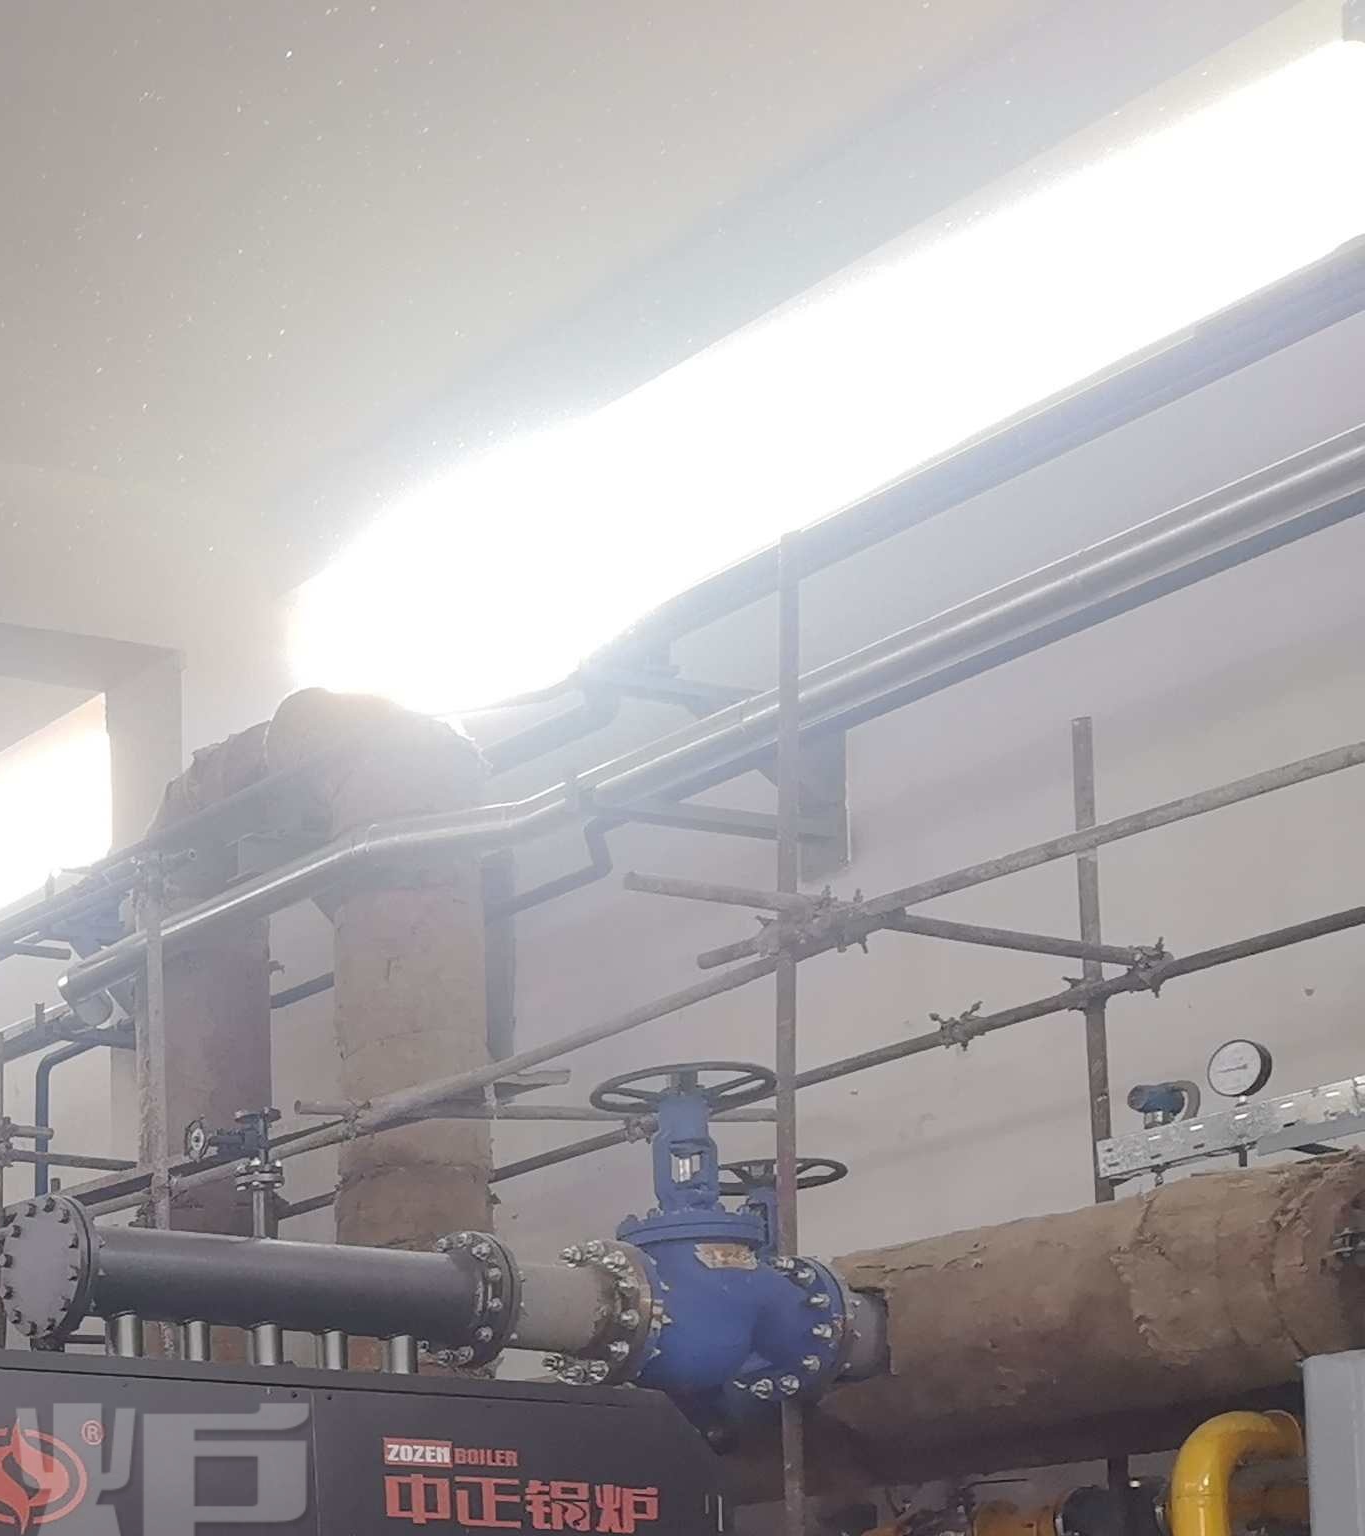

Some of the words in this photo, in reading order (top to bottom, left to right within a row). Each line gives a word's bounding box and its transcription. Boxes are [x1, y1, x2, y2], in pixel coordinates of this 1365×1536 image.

[386, 1443, 451, 1463] ZOZEN
[454, 1447, 518, 1467] BOILER
[383, 1473, 660, 1534] 中正锅炉
